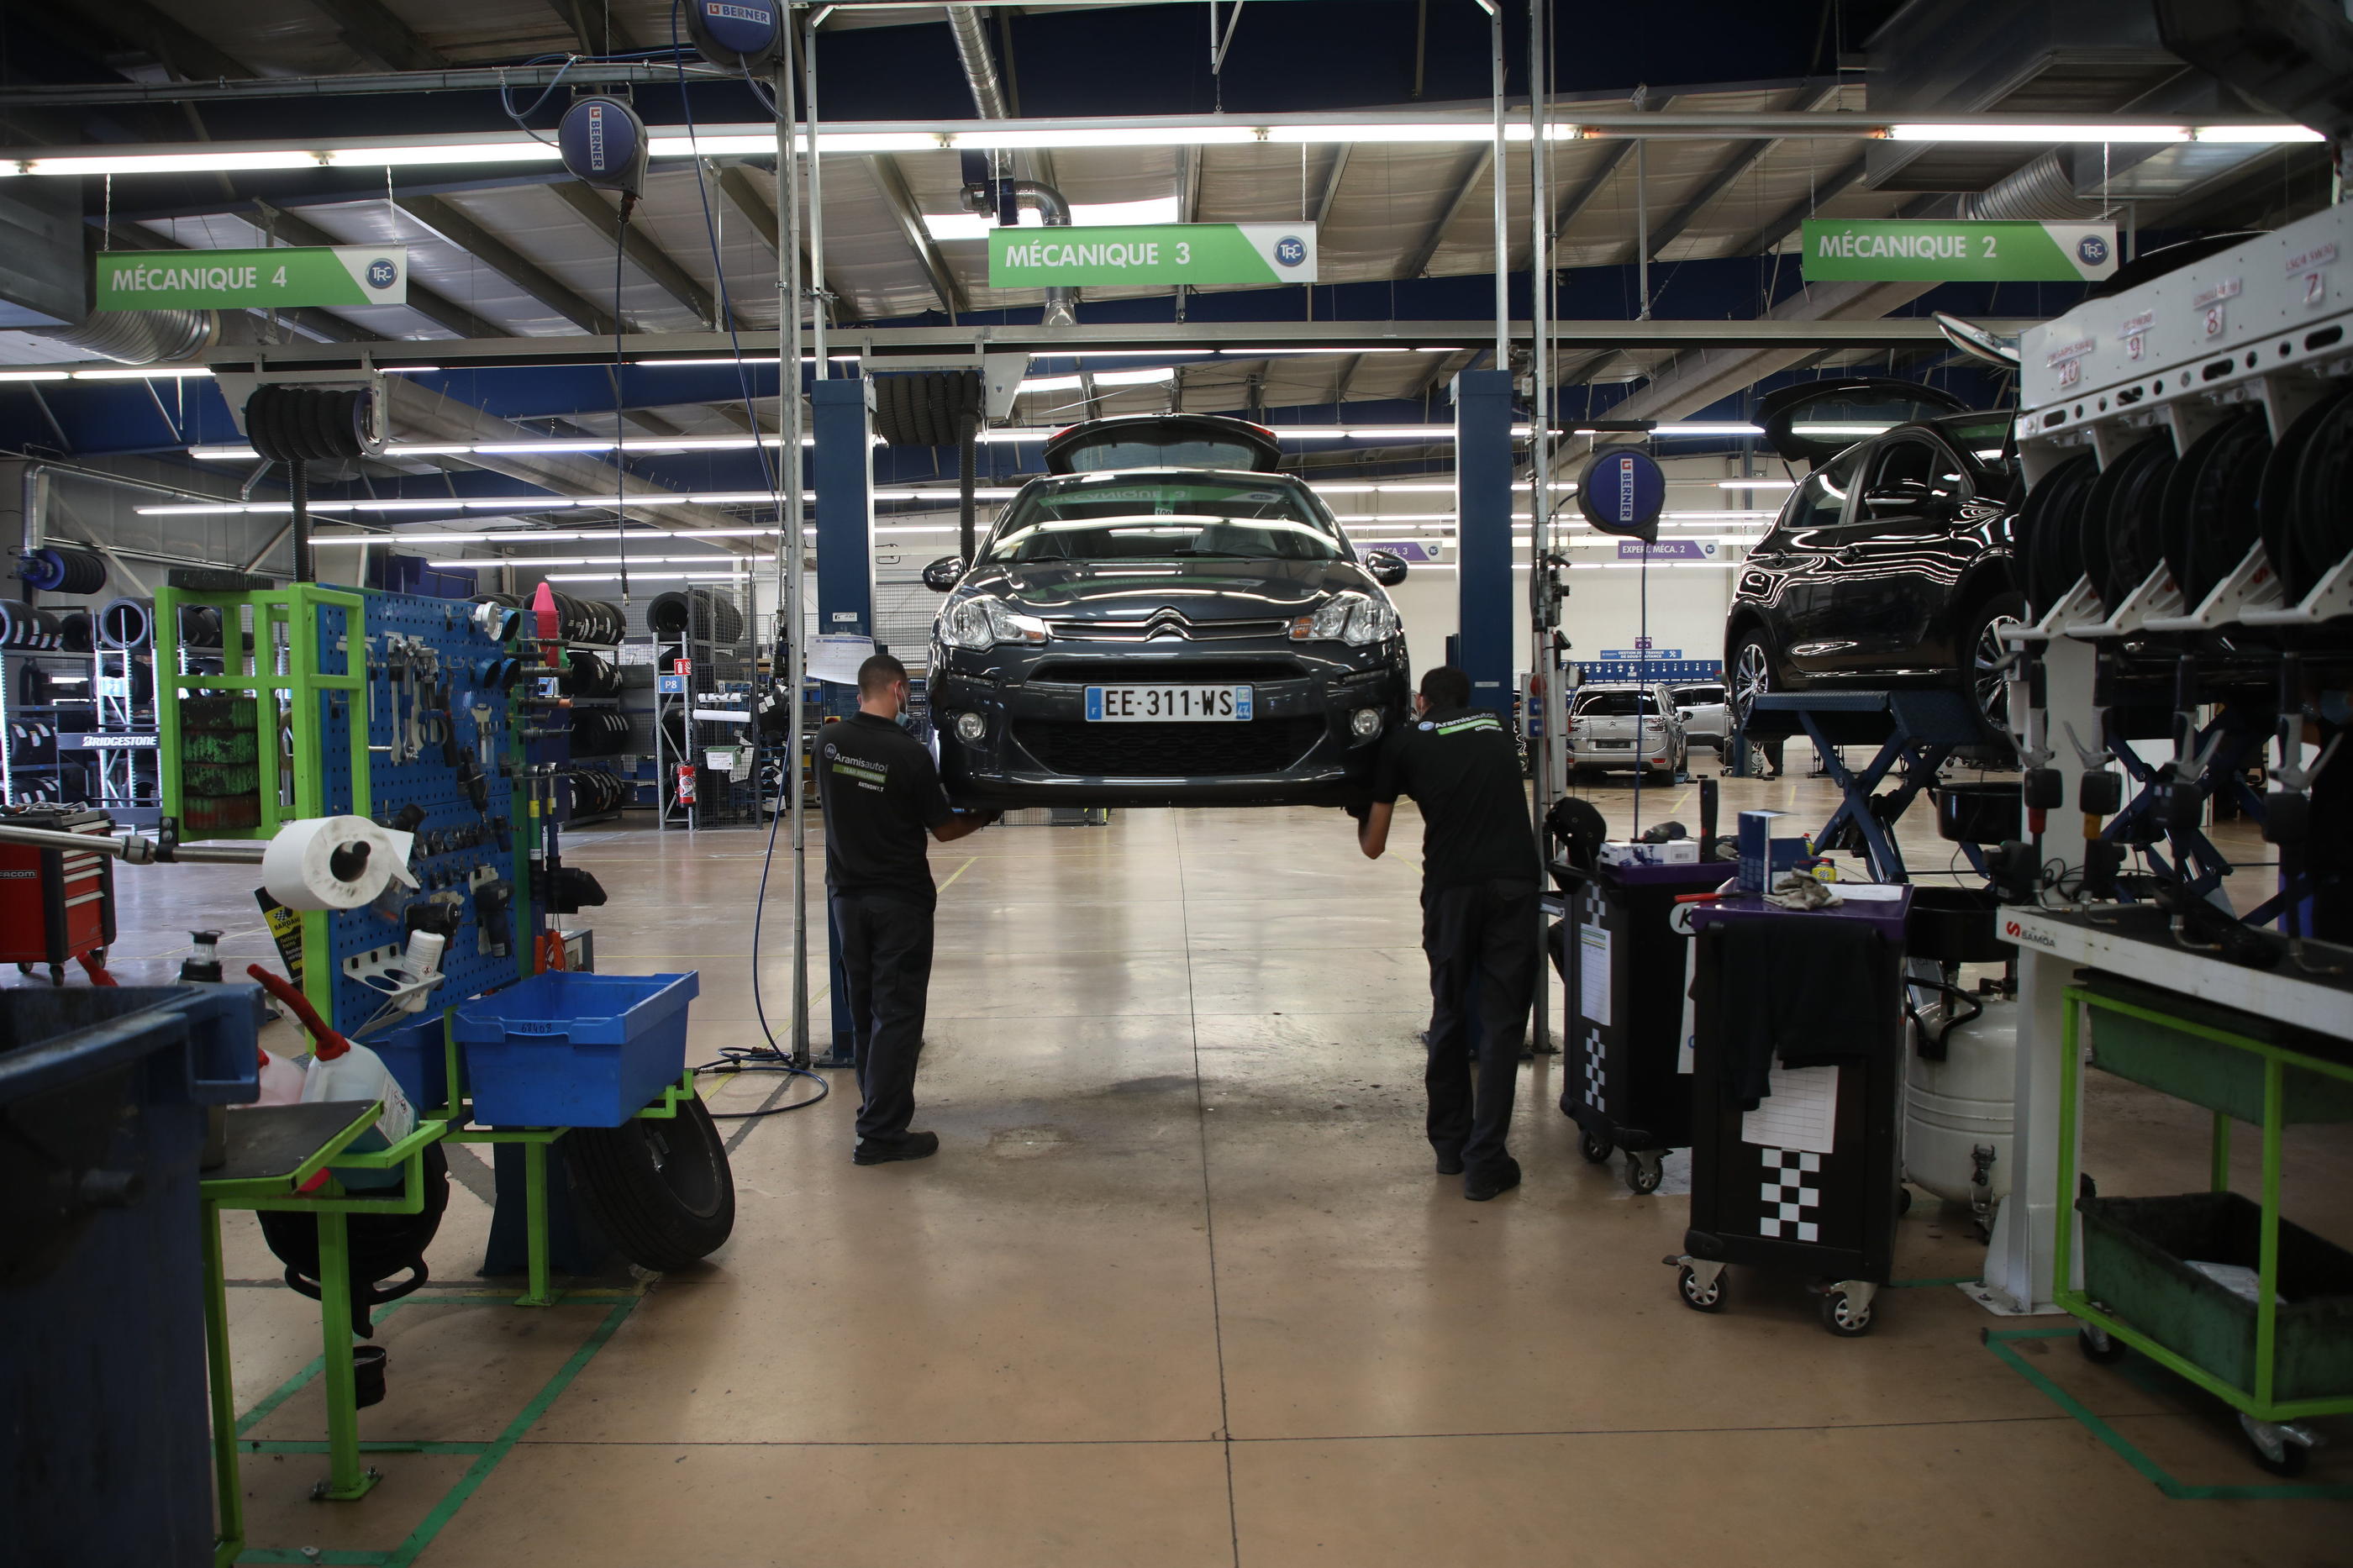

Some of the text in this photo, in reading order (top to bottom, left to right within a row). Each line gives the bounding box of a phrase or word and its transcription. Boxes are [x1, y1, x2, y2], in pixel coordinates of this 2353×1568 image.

[723, 6, 768, 23] BERNER
[591, 120, 603, 168] BERNER
[1005, 239, 1191, 268] MÉCANIQUE 3
[1818, 230, 1998, 260] MÉCANIQUE 2
[111, 264, 288, 292] MÉCANIQUE 4
[2304, 272, 2319, 300] 7
[2207, 308, 2218, 334] 8
[2129, 337, 2140, 360] 9
[2060, 360, 2078, 386] 10
[1622, 472, 1632, 518] BERNER
[1653, 544, 1678, 554] MÉCA.
[665, 681, 677, 689] P8
[1092, 707, 1097, 715] F
[1105, 690, 1233, 716] EE-311-WS
[82, 736, 158, 747] BRIDGESTONE
[834, 753, 886, 772] Aramisauto
[2021, 930, 2056, 947] SAMOA
